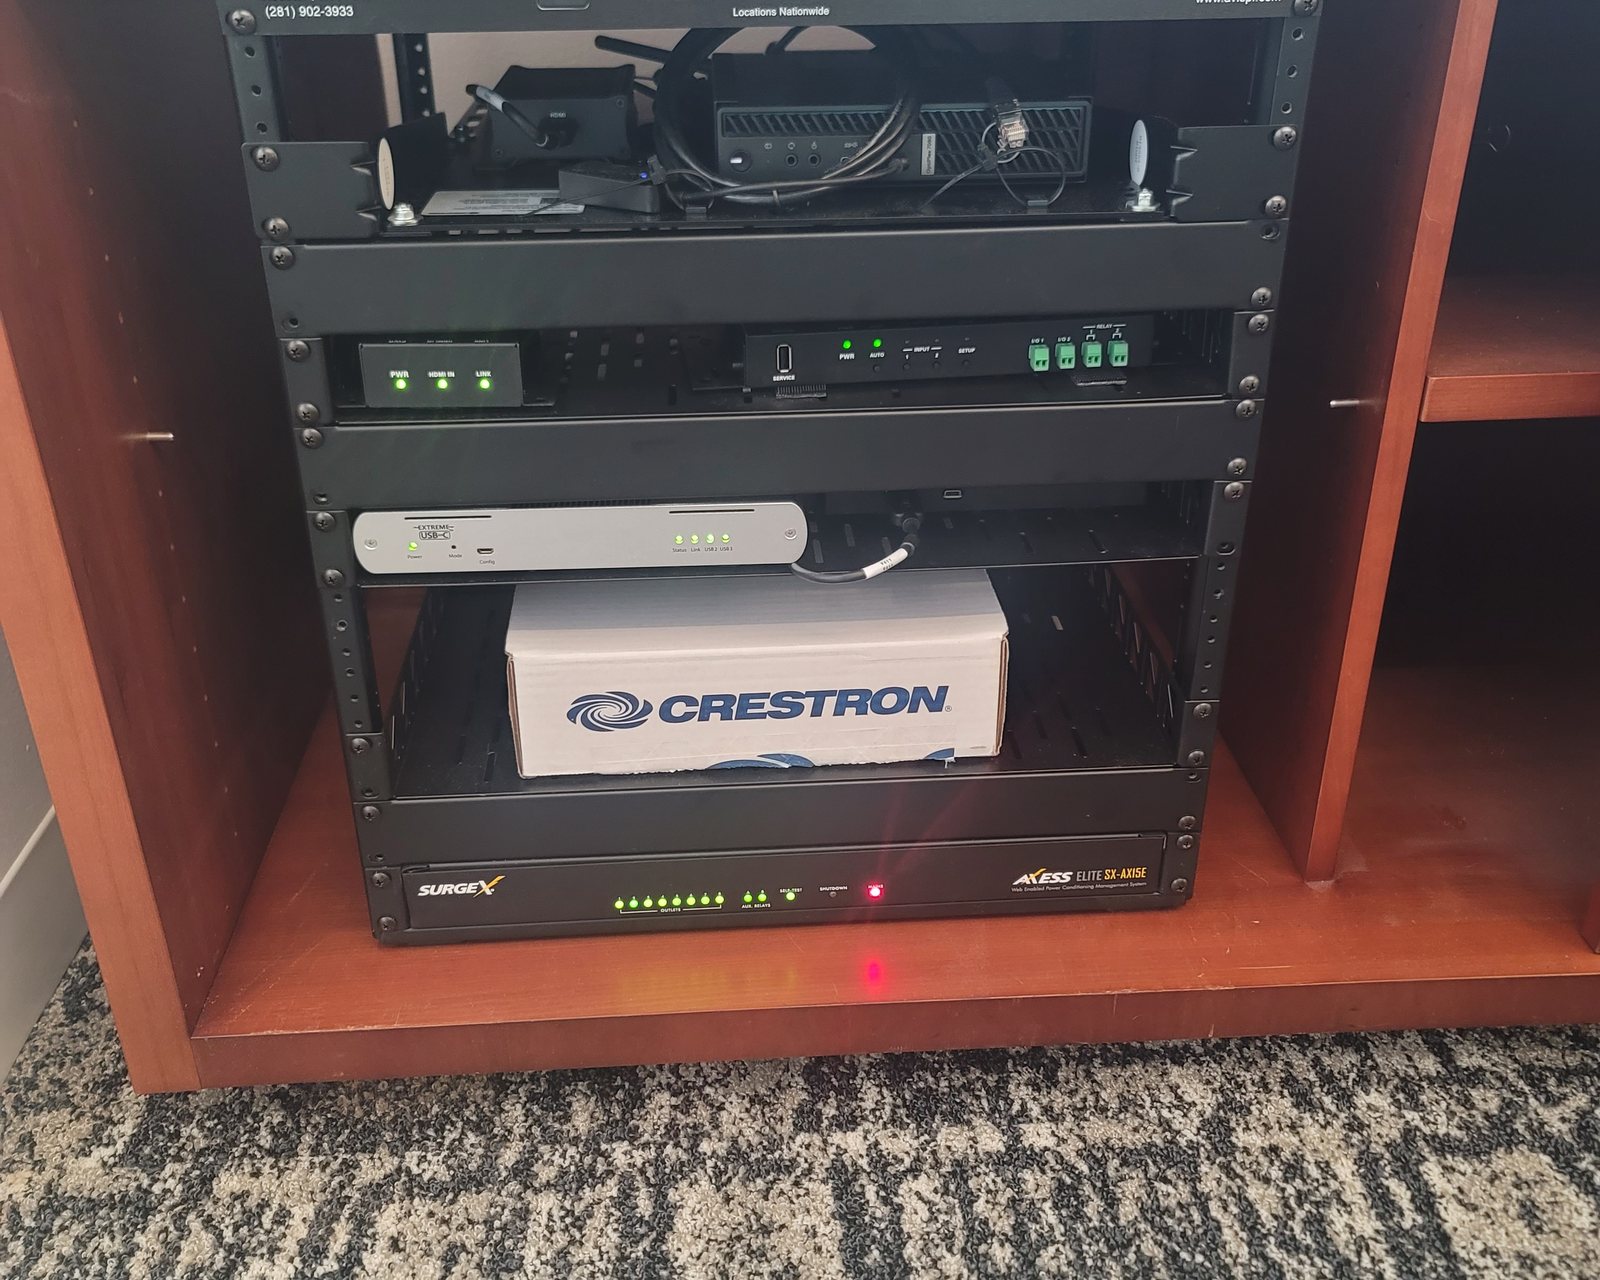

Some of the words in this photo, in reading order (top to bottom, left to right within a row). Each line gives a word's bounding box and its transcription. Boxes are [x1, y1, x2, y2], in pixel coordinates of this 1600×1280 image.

[265, 5, 296, 20] (281)
[298, 5, 354, 17] 902-3933
[732, 8, 777, 17] Locations
[779, 6, 830, 16] Nationwide
[390, 370, 410, 378] PWR
[773, 374, 795, 382] SERVICE
[420, 531, 449, 540] USB-C
[658, 685, 949, 723] CRESTRON
[1012, 868, 1074, 886] AXESS
[1076, 870, 1103, 882] ELITE
[418, 876, 505, 897] SURGEX
